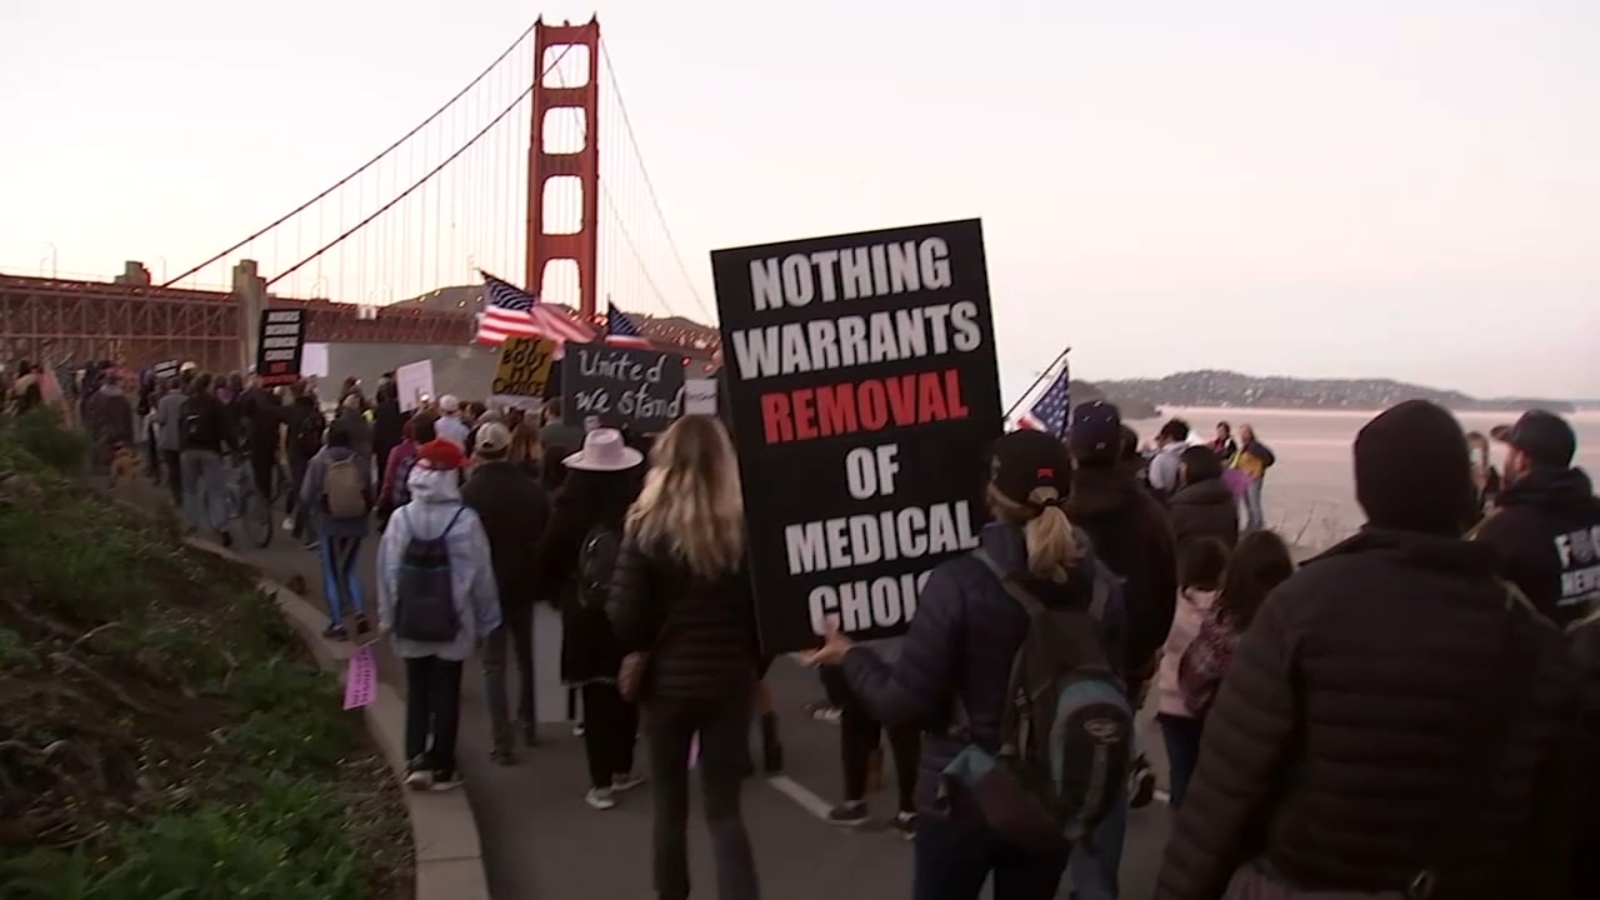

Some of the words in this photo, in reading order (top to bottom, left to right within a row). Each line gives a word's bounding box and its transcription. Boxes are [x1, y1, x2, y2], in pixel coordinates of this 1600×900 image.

[749, 237, 951, 311] NOTHING
[577, 349, 667, 383] United
[731, 300, 981, 380] WARRANTS
[760, 369, 969, 445] REMOVAL
[846, 444, 900, 499] OF
[785, 500, 980, 575] MEDICAL
